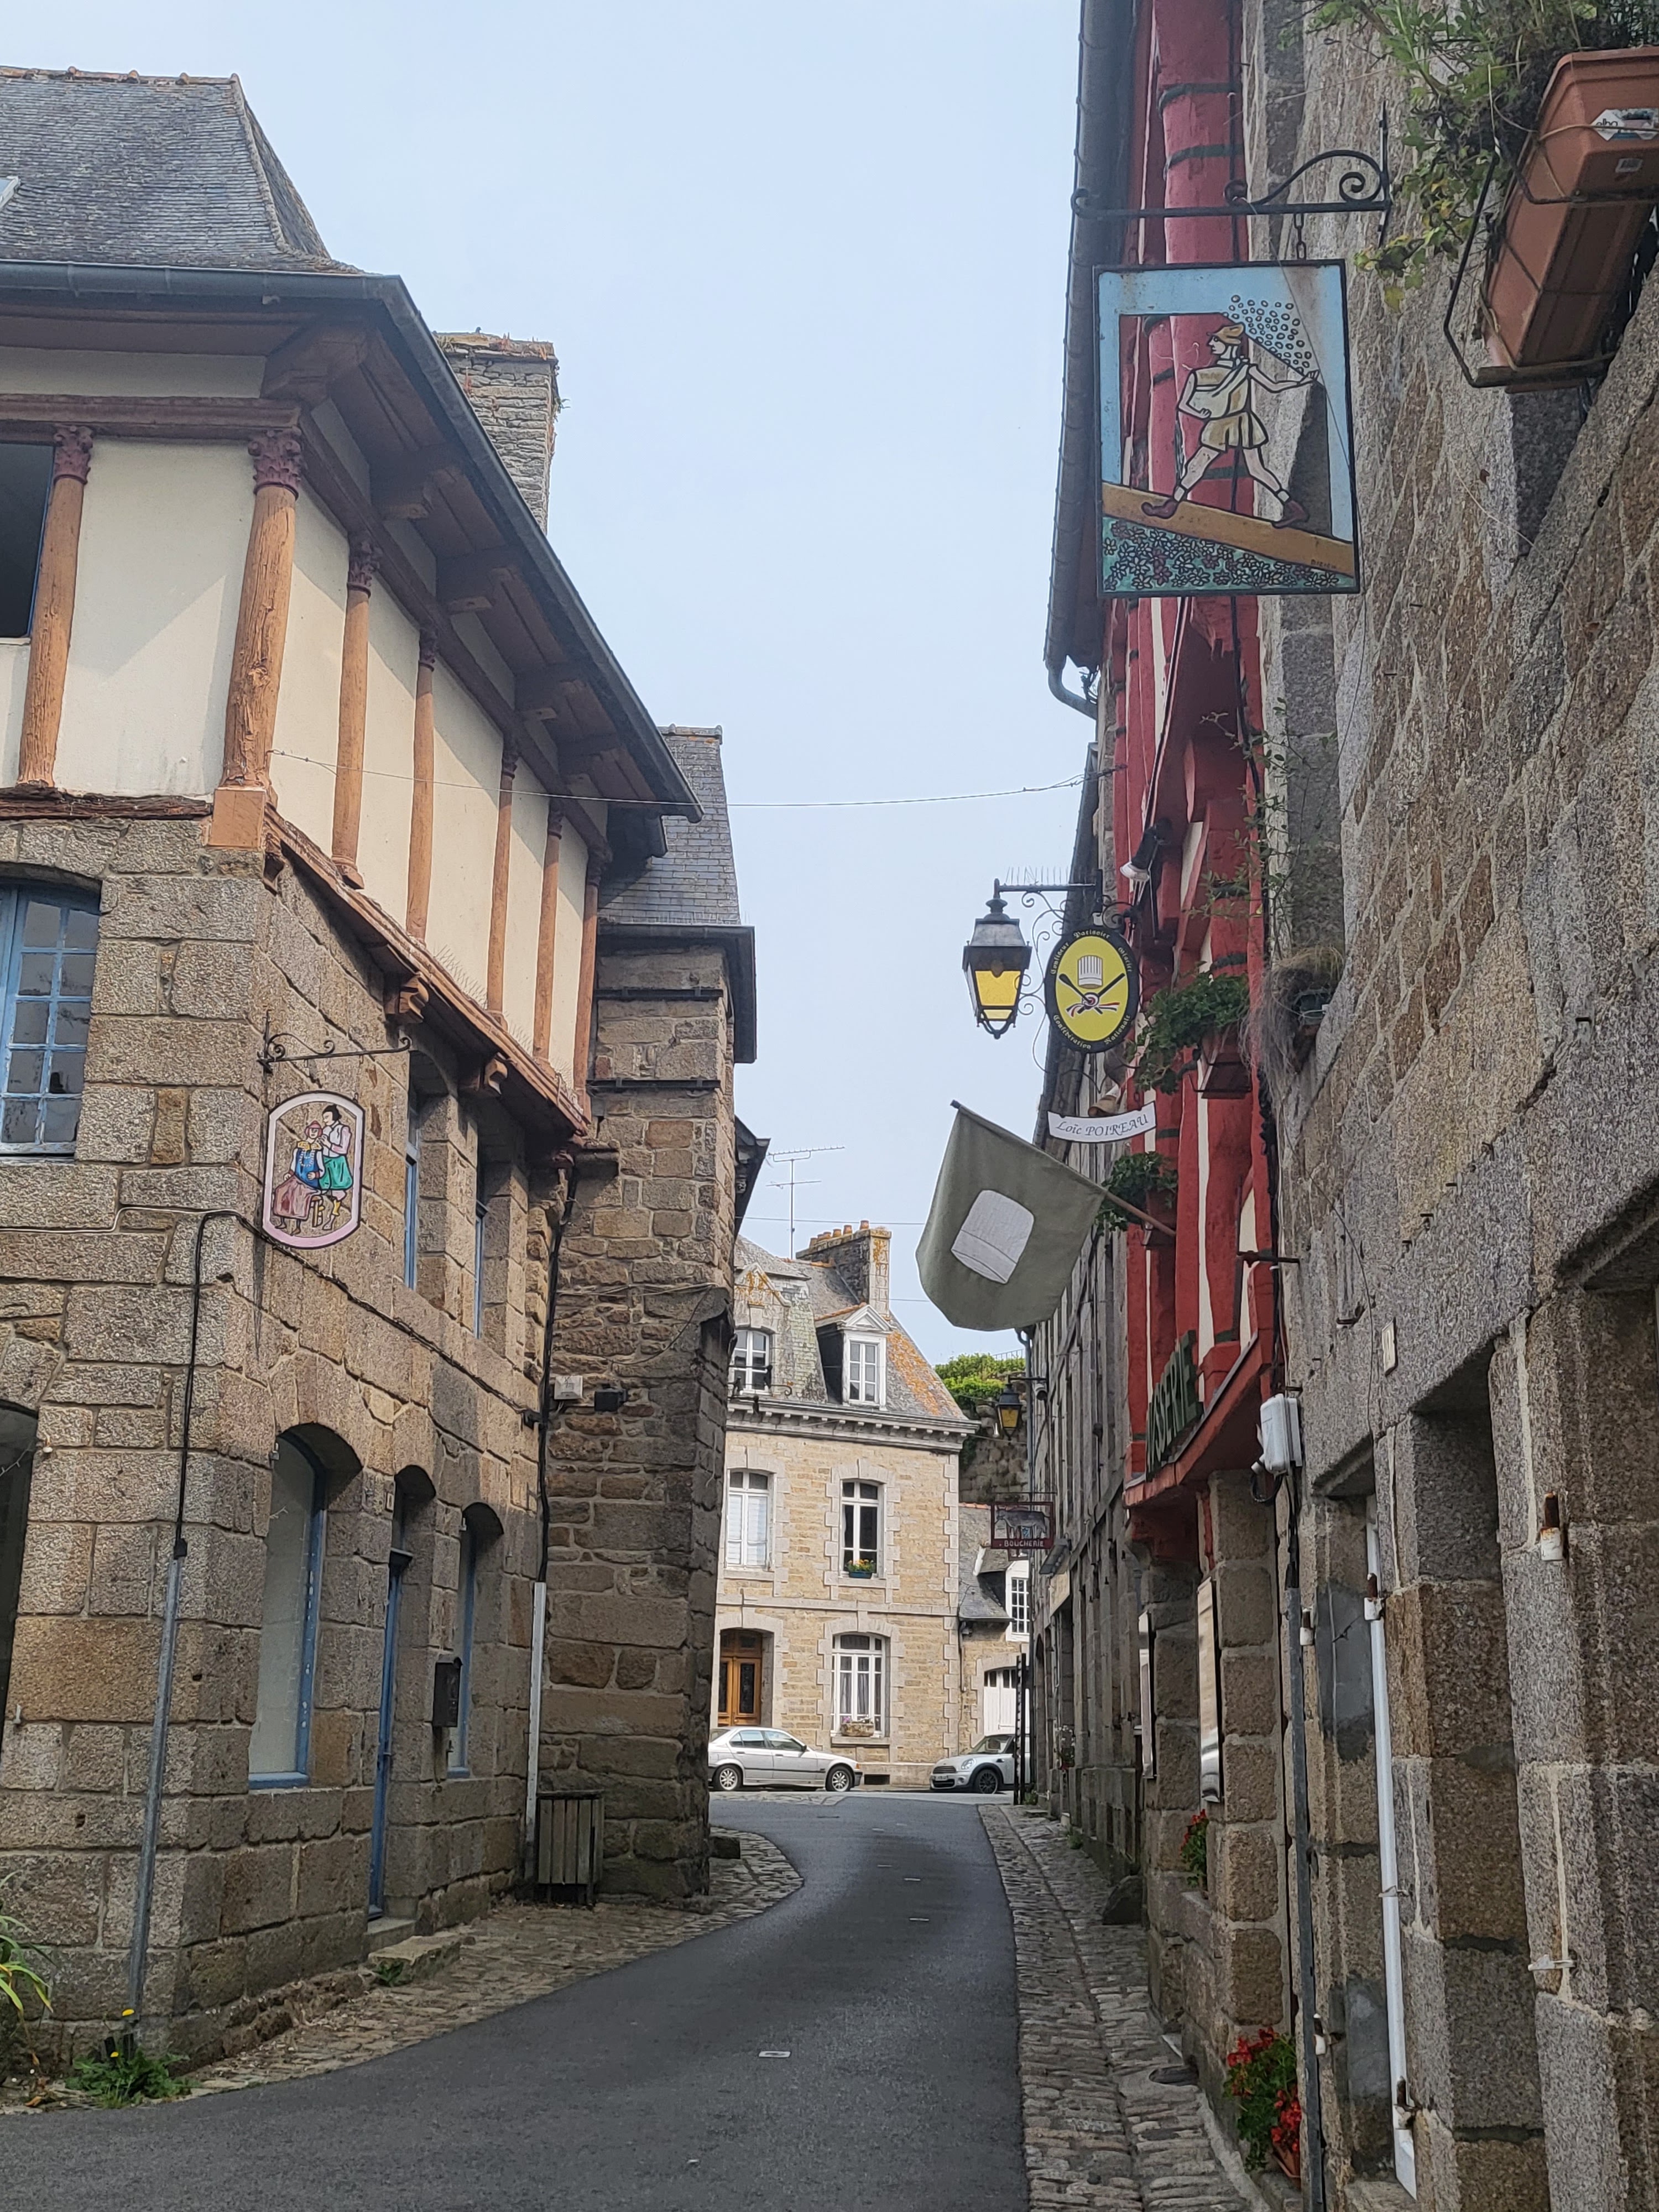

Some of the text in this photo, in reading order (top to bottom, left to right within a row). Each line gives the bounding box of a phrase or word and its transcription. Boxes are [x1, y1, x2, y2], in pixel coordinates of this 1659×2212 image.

[1050, 942, 1070, 974] Confiseur
[1118, 947, 1133, 972] Glacier
[1104, 1015, 1130, 1045] Nationale
[1055, 1114, 1149, 1136] Loïc POIREAU
